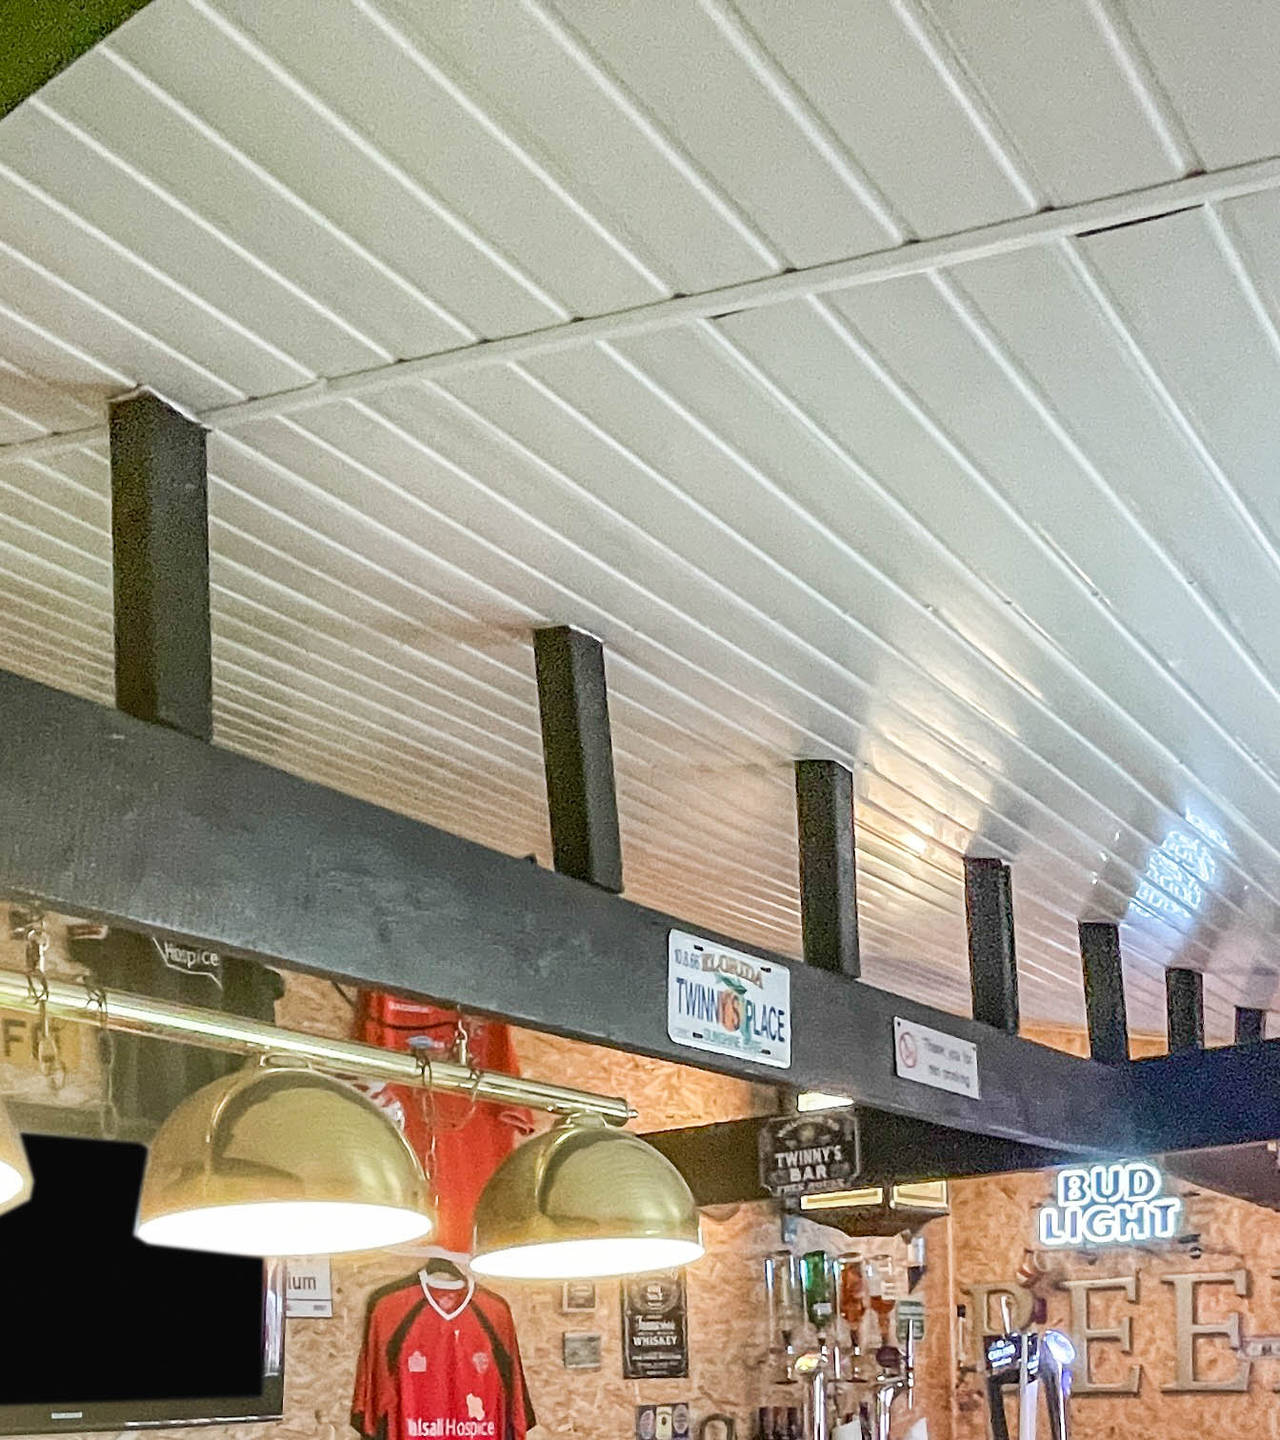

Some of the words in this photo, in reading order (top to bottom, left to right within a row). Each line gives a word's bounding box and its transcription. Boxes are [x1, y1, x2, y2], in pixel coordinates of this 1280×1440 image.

[700, 952, 764, 990] FLORIDA
[675, 976, 741, 1033] TWINNY'S
[744, 999, 786, 1043] PLACE
[774, 1144, 842, 1169] TWINNY'S
[789, 1164, 827, 1182] BAR
[1057, 1162, 1162, 1208] BUD
[1039, 1197, 1182, 1246] LIGHT
[632, 1335, 677, 1346] WHISKEY
[445, 1417, 496, 1440] Hospice
